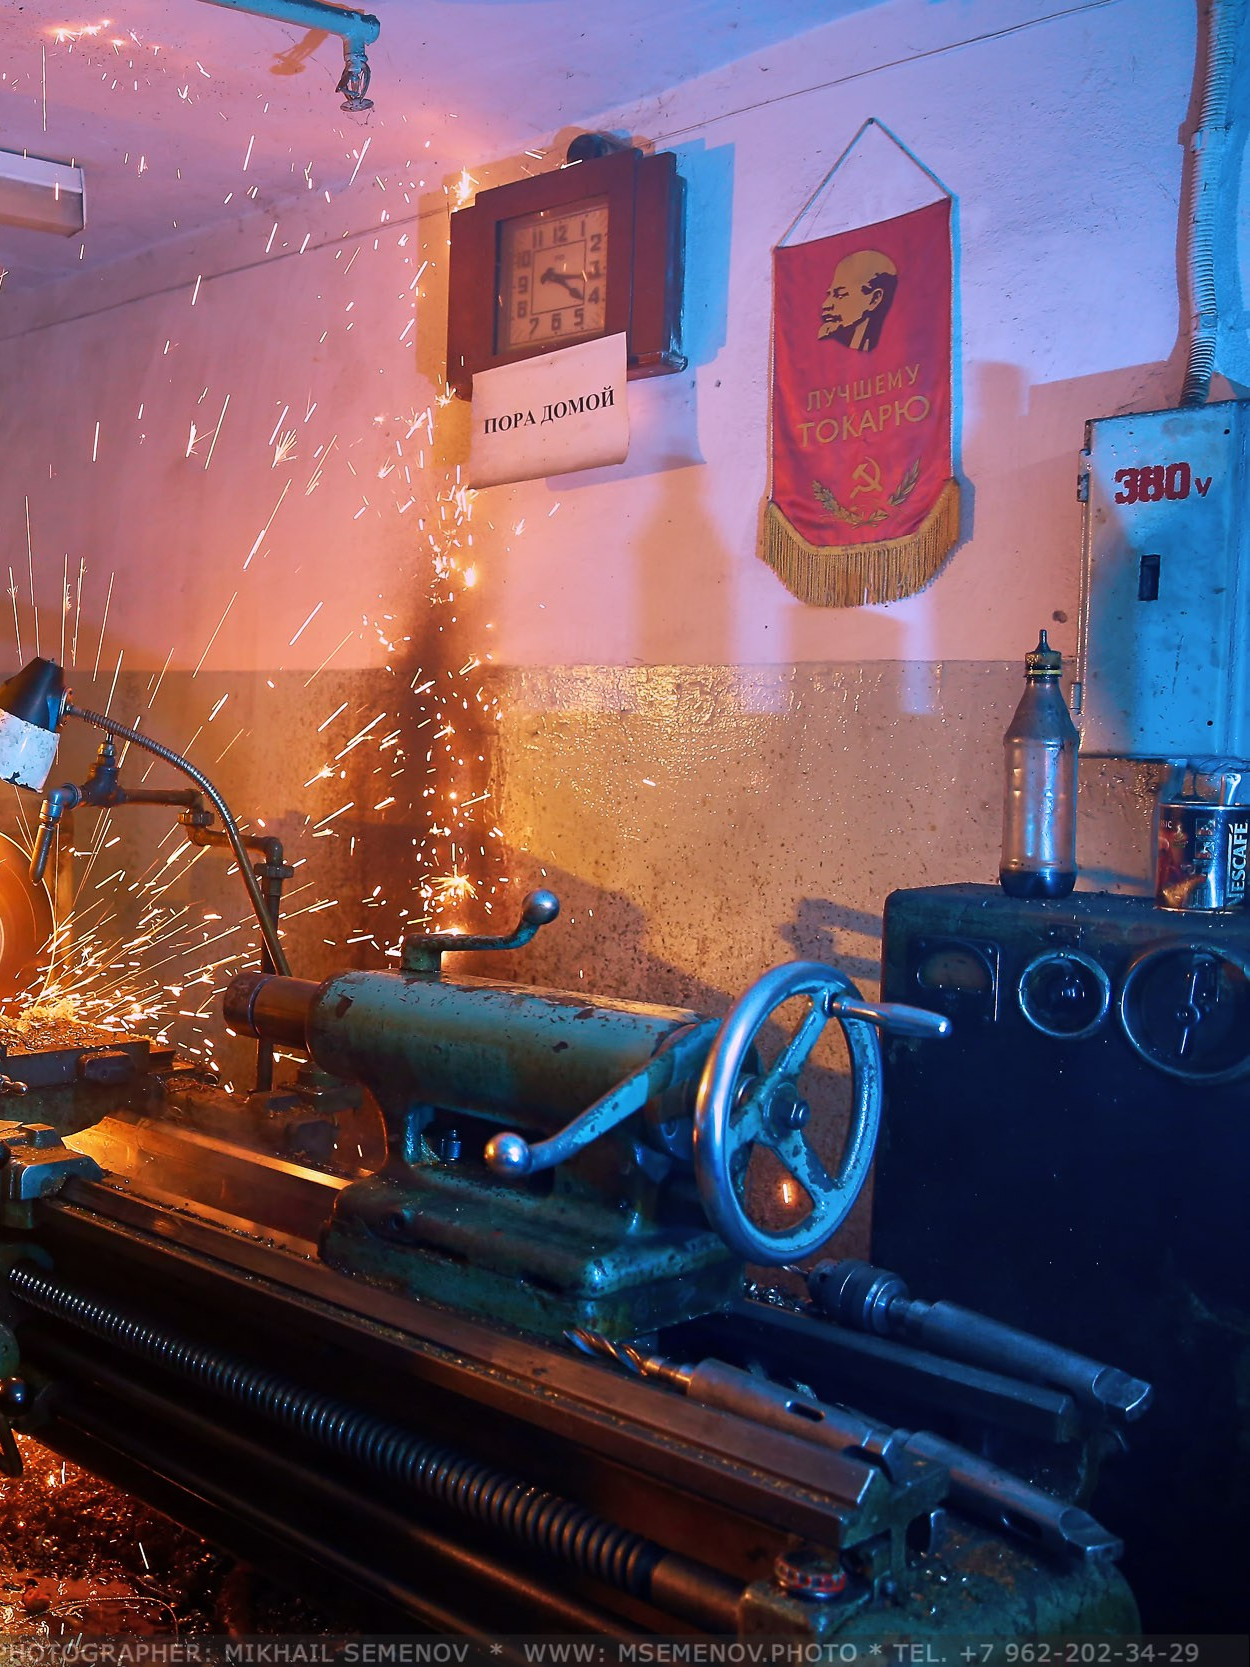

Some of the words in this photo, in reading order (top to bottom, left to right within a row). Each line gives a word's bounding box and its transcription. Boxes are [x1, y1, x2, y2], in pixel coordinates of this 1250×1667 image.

[553, 225, 568, 244] 12
[580, 220, 586, 237] 1
[533, 229, 543, 249] 11
[590, 233, 602, 252] 2
[517, 250, 530, 268] 10
[518, 276, 528, 294] 9
[588, 286, 600, 304] 4
[517, 301, 528, 319] 8
[574, 308, 584, 326] 5
[529, 318, 539, 336] 7
[551, 312, 561, 331] 6
[806, 363, 921, 412] ЛУЧШЕМУ
[484, 410, 536, 434] ПОРА
[541, 385, 615, 425] ДОМОЙ
[797, 395, 931, 448] ТОКАРЮ
[1114, 462, 1191, 505] 380
